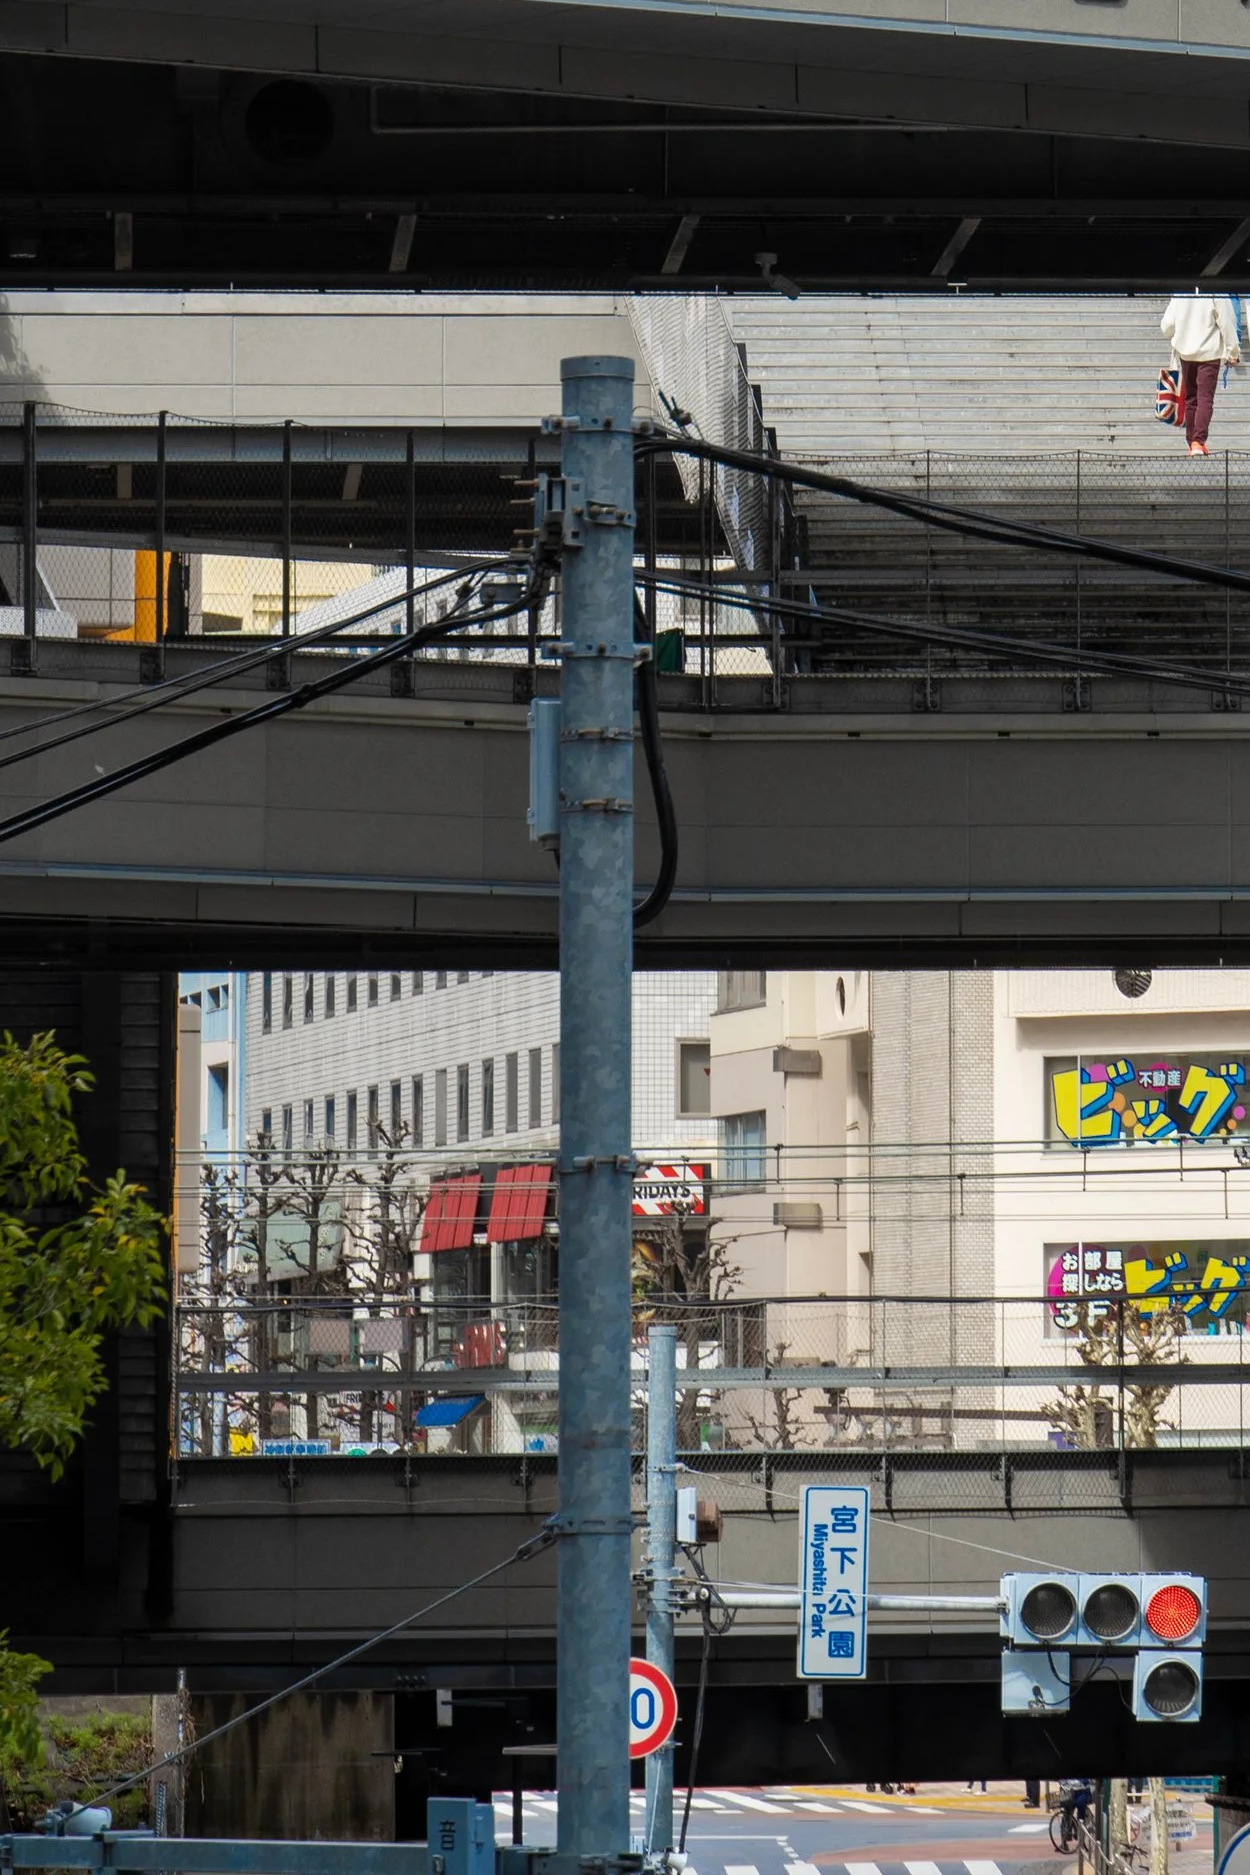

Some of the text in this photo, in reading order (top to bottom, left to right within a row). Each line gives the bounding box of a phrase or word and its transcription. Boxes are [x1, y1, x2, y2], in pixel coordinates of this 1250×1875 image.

[1053, 1058, 1246, 1146] ビッグ
[1138, 1070, 1182, 1088] 不動産
[1062, 1250, 1123, 1272] お部屋
[1062, 1272, 1124, 1293] 探しなら
[810, 1523, 829, 1639] Miyashita Park
[828, 1505, 859, 1659] 宮下公園
